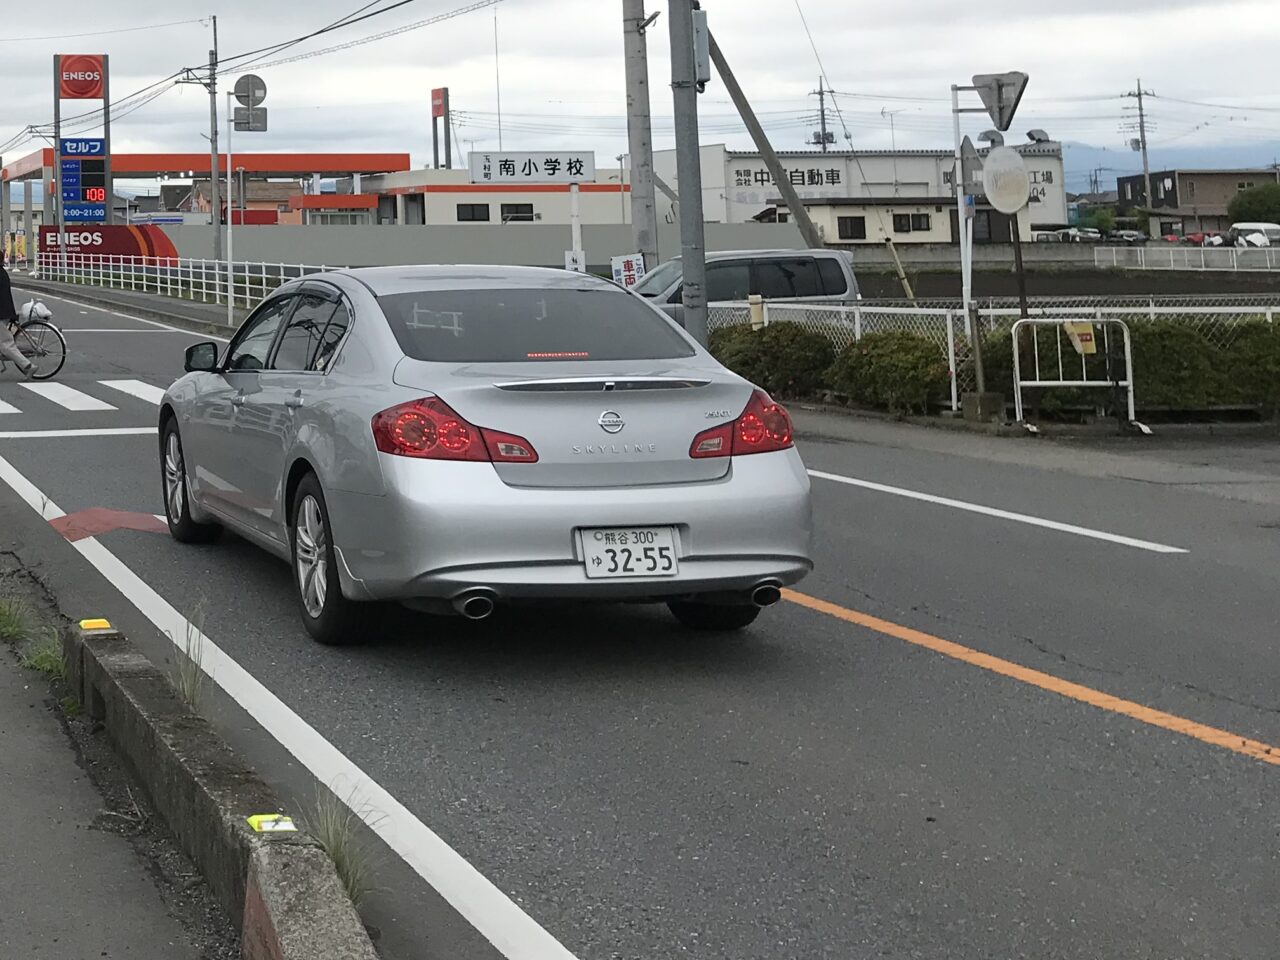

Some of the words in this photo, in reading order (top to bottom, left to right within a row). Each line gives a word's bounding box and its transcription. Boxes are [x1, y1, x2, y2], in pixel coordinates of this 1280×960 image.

[62, 71, 101, 81] ENEOS
[64, 141, 101, 153] セルフ
[498, 158, 584, 177] 南小学校
[754, 168, 841, 186] 中自動車
[86, 188, 105, 201] 108
[622, 259, 636, 288] 車両
[572, 443, 657, 455] SKYLINE
[604, 532, 629, 546] 熊谷
[631, 531, 654, 544] 300
[591, 555, 603, 568] ゆ
[604, 546, 673, 573] 32-55
